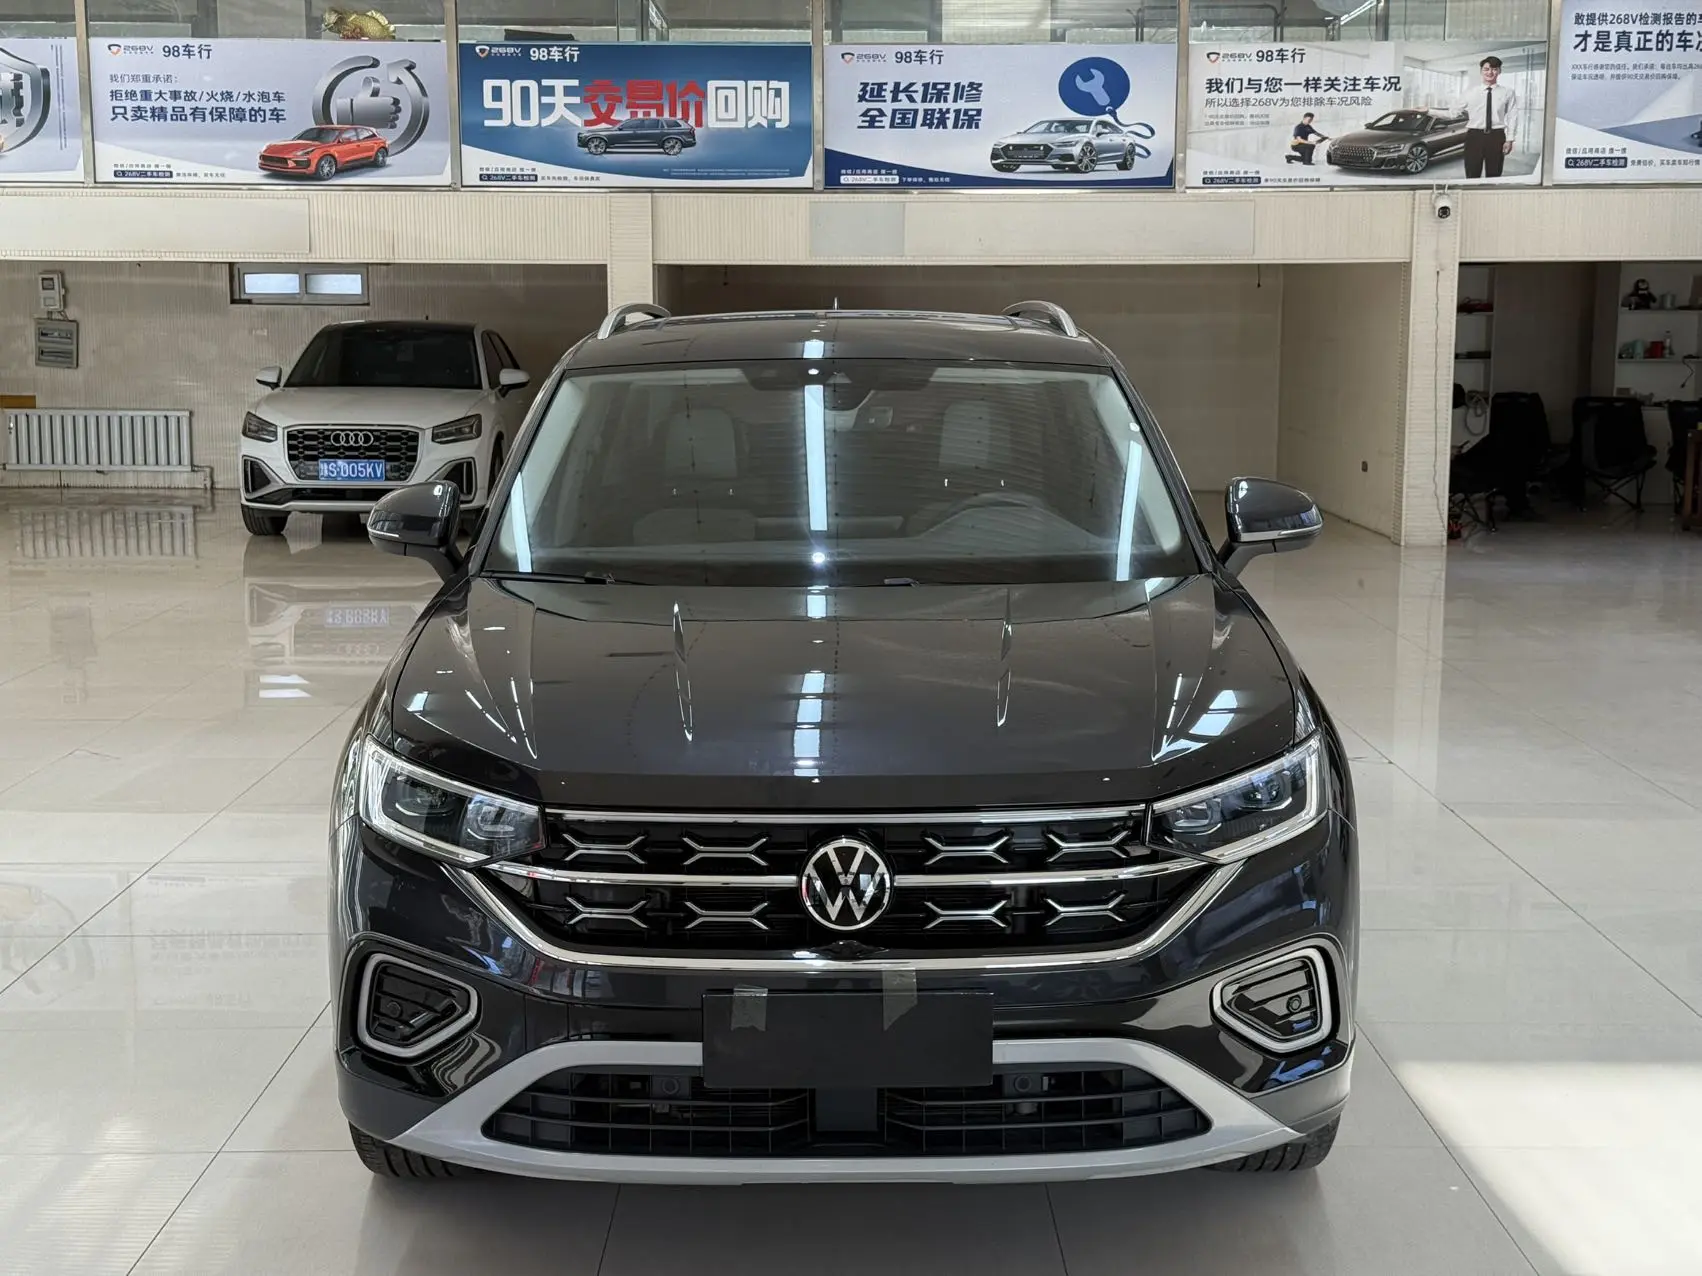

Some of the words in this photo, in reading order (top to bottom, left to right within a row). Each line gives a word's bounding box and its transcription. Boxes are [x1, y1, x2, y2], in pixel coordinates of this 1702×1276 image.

[162, 44, 212, 59] 98车行
[529, 46, 580, 62] 98车行
[894, 49, 944, 65] 98车行
[1256, 48, 1306, 63] 98车行
[109, 74, 178, 84] 我们郑重承诺：
[1205, 76, 1402, 94] 我们与您一样关注车况
[109, 89, 286, 103] 拒绝重大事故/火烧/水泡车
[857, 81, 983, 104] 延长保修
[483, 79, 790, 128] 90天交易价回购
[1205, 96, 1373, 108] 所以选择268V为您排除车况风险
[110, 105, 287, 124] 只卖精品有保障的车
[857, 107, 983, 130] 全国联保
